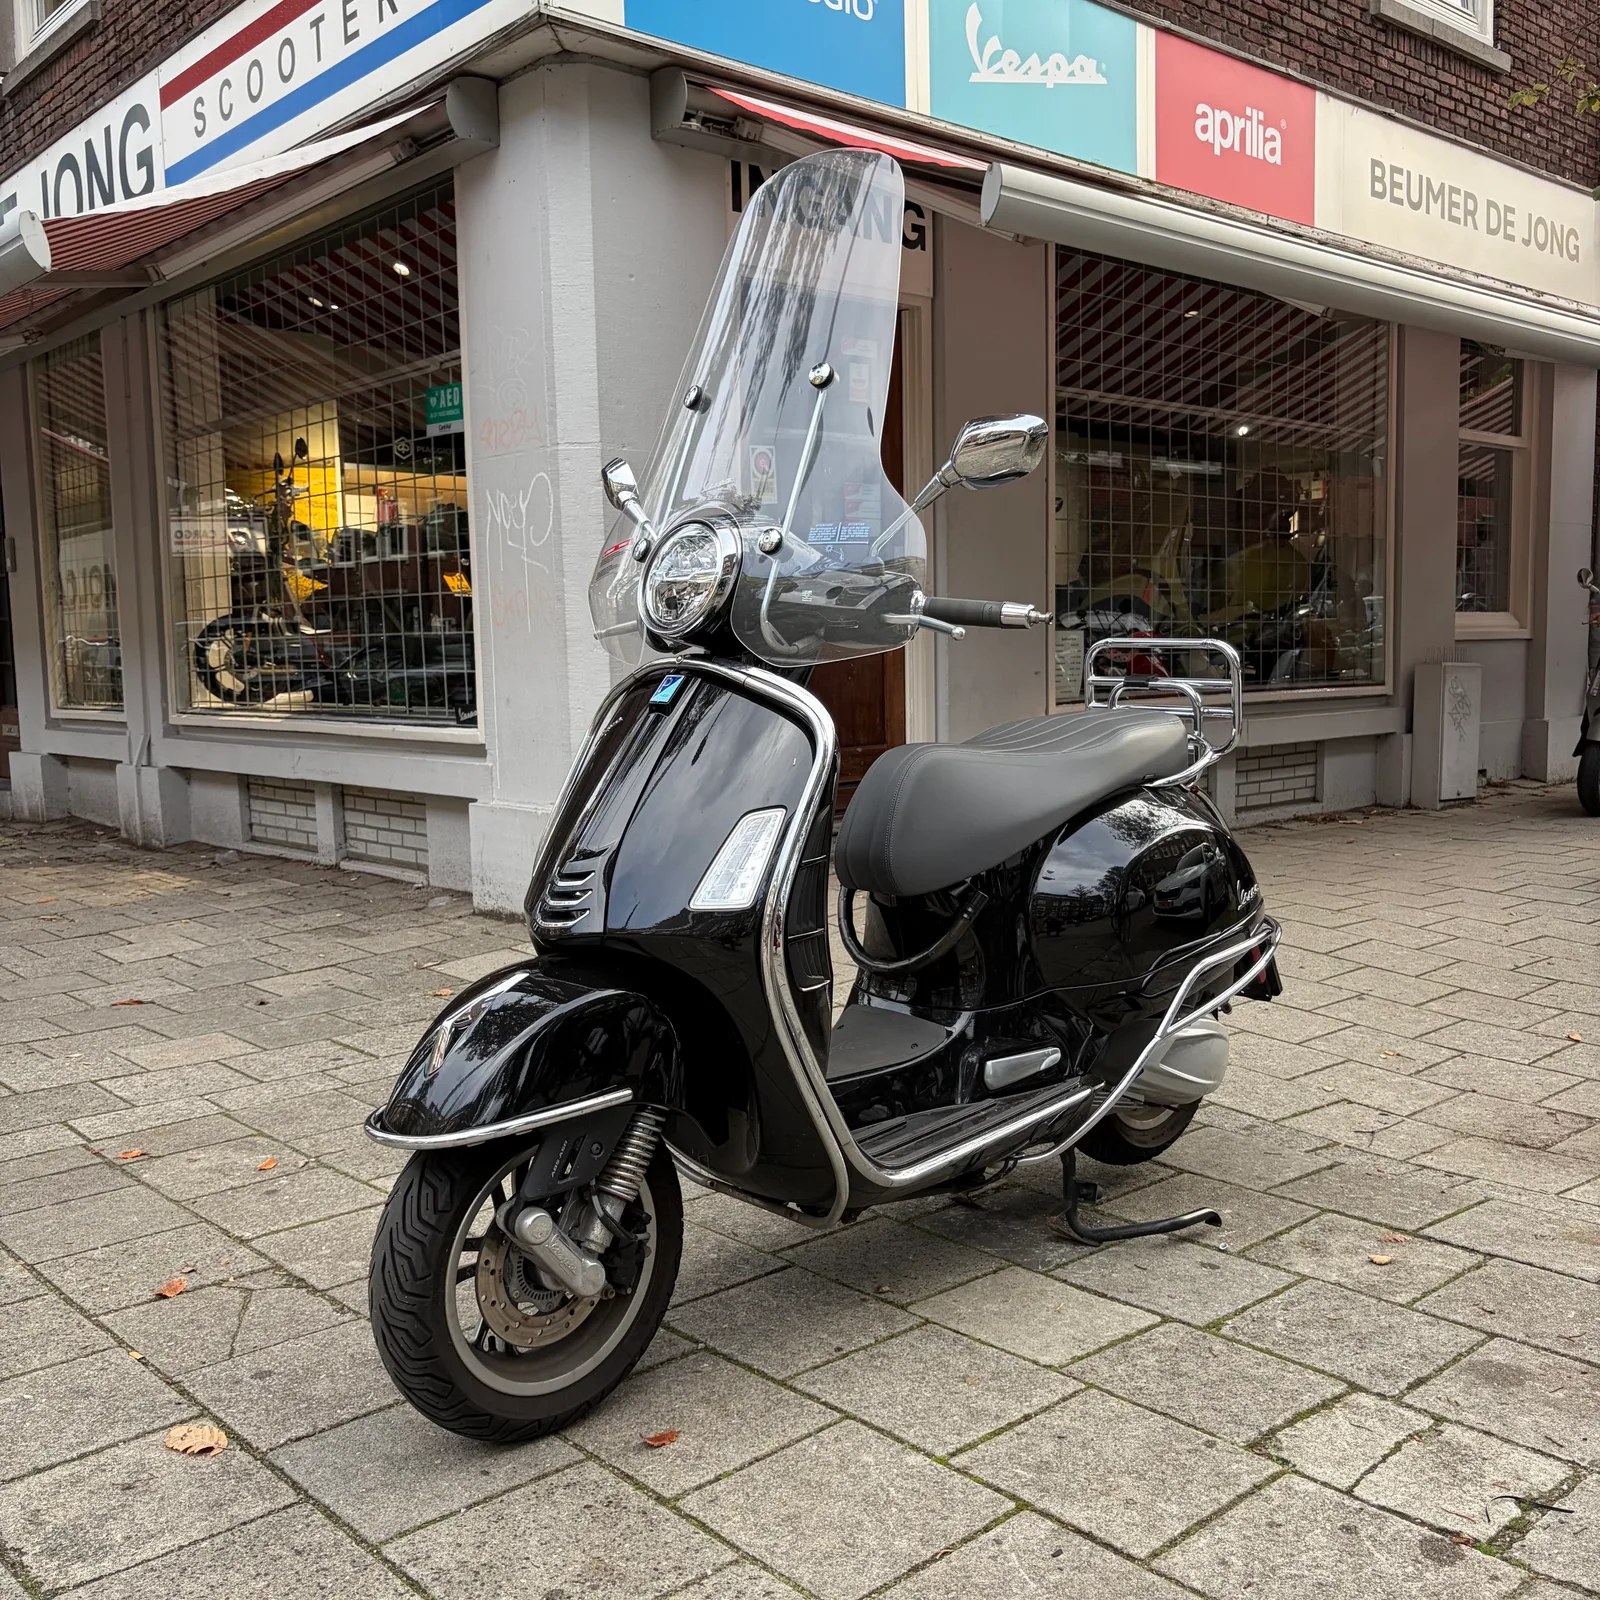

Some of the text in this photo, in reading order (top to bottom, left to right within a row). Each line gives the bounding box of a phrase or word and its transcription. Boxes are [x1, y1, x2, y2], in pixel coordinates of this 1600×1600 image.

[966, 2, 1108, 88] Vespa
[1194, 103, 1282, 166] aprilia
[731, 159, 926, 252] INGANG
[1370, 157, 1580, 263] BEUMER DE JONG
[439, 387, 460, 408] AED
